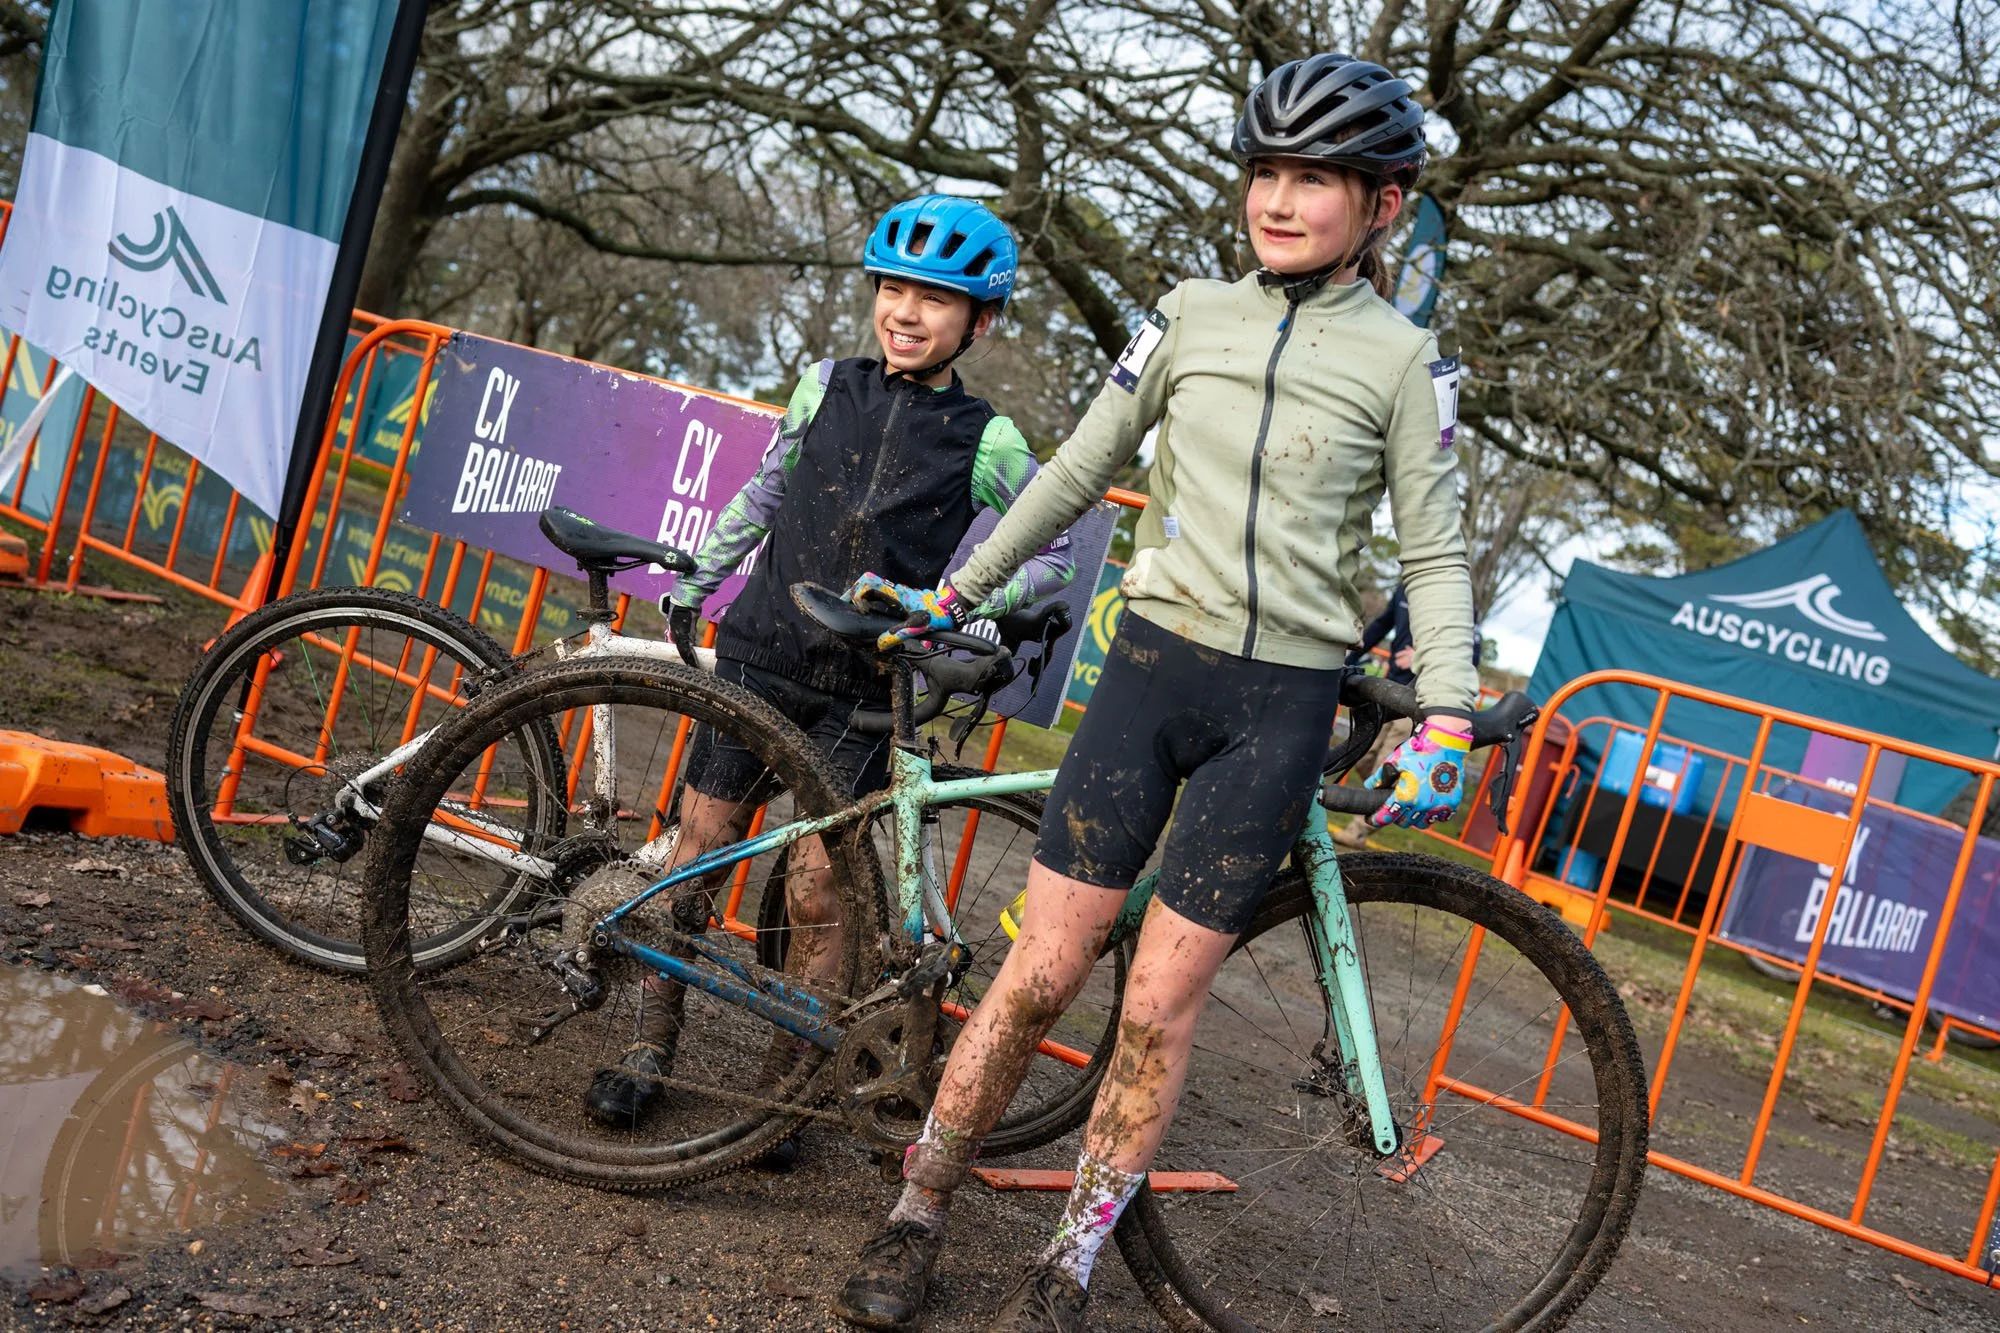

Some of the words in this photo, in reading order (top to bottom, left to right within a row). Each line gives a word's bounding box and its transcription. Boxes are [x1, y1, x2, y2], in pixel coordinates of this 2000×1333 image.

[475, 366, 521, 444] CX
[451, 442, 562, 513] BALLARAT
[672, 419, 722, 501] CX
[949, 602, 966, 624] FIST
[1671, 601, 1891, 686] AUSCYCLING
